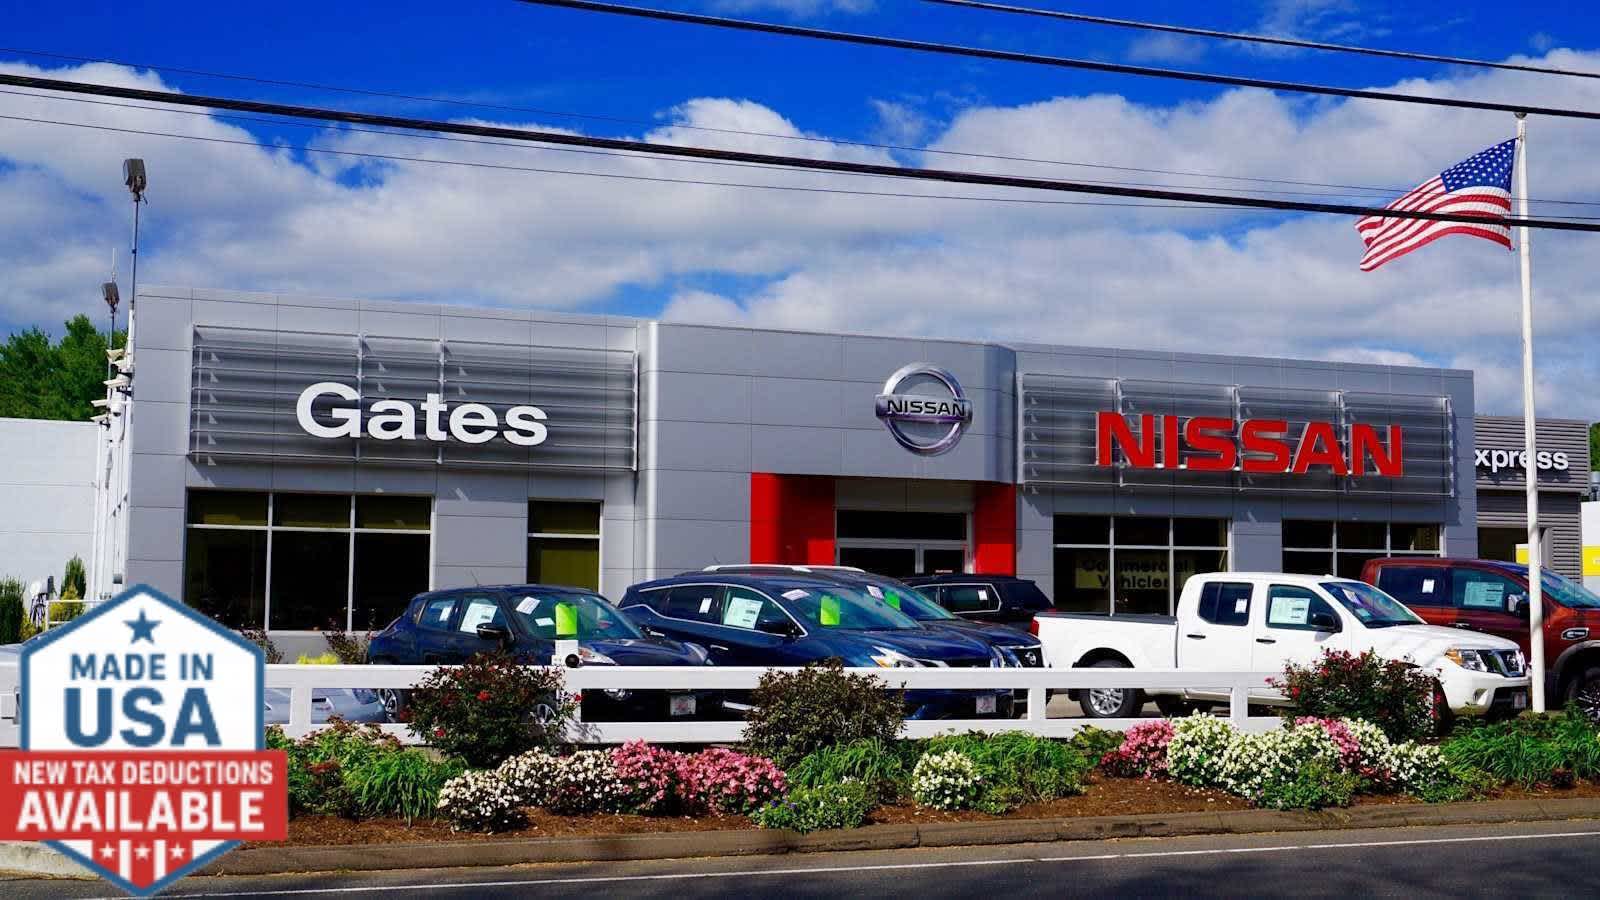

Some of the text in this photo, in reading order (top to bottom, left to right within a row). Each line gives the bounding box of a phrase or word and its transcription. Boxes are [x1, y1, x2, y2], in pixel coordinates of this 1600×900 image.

[296, 381, 548, 446] Gates
[887, 399, 966, 416] NISSAN
[1095, 411, 1403, 477] NISSAN
[1098, 575, 1169, 588] Vhicle
